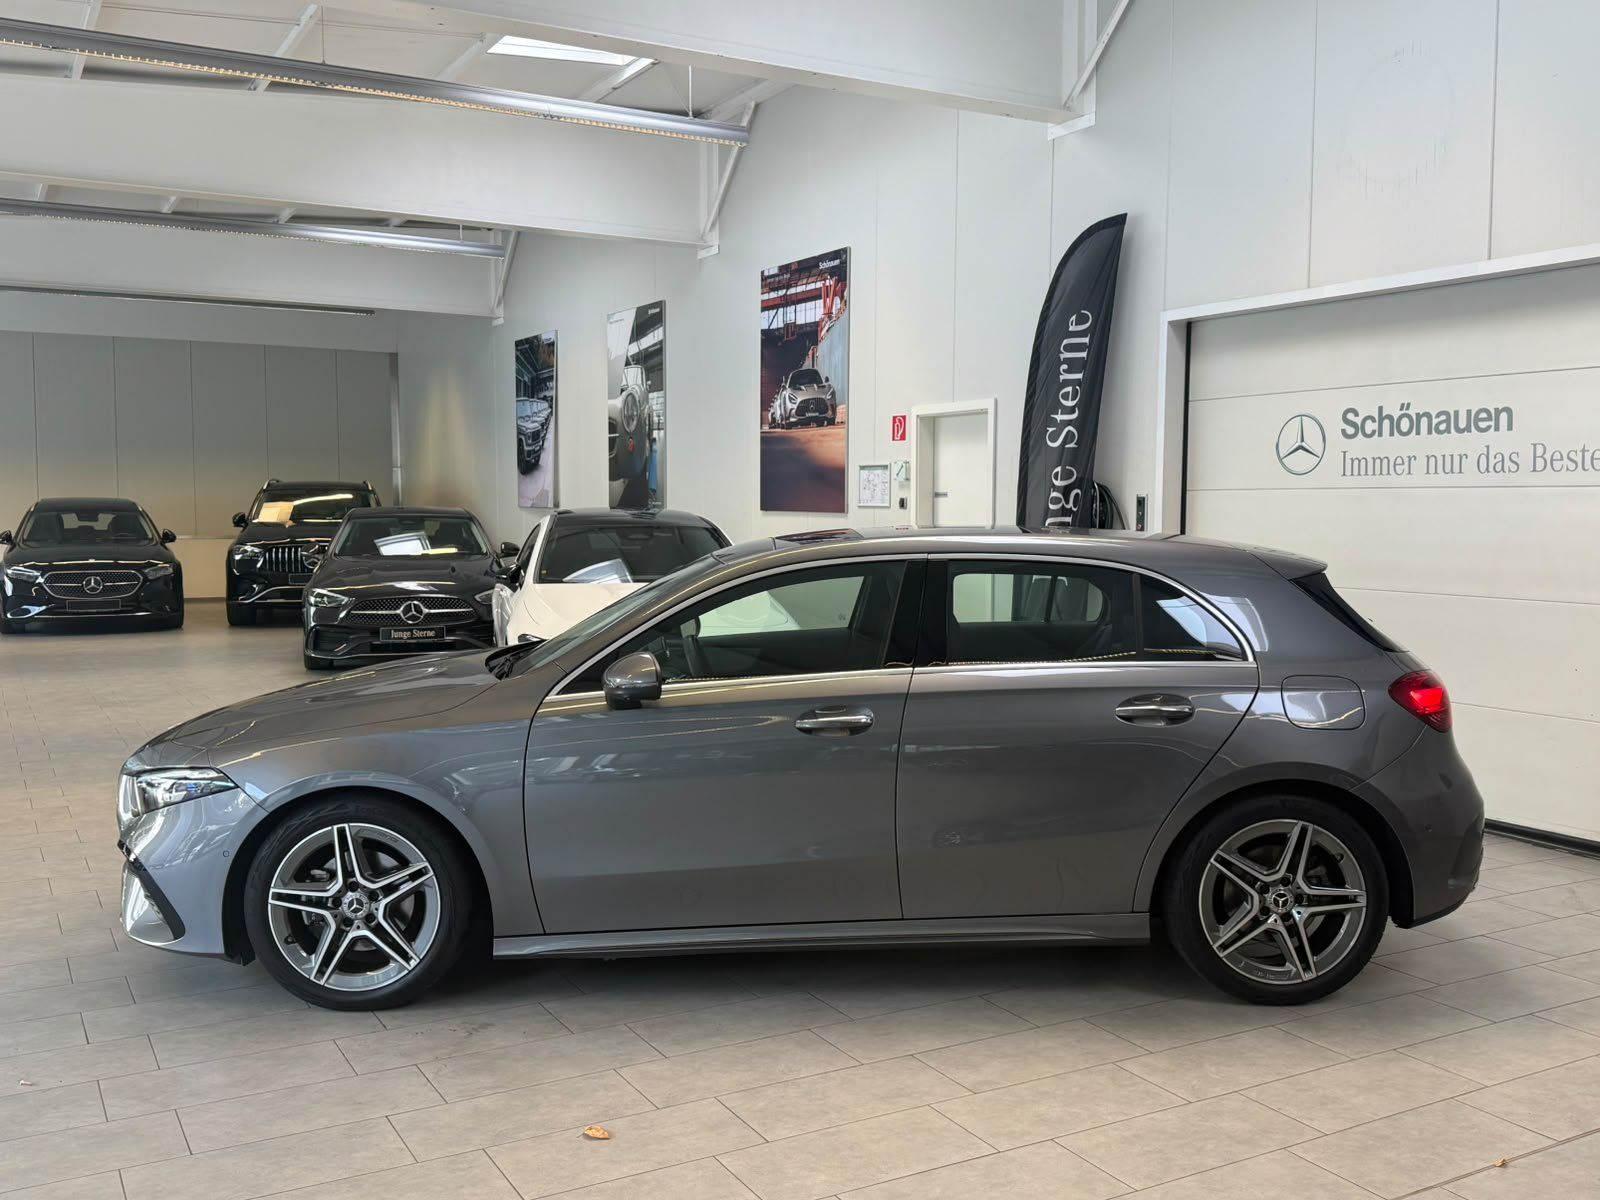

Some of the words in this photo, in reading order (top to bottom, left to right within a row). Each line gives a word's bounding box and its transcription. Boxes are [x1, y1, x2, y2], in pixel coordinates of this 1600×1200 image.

[1045, 309, 1093, 448] Sterne
[1340, 402, 1513, 440] Schönauen
[1340, 450, 1417, 477] Immer
[1424, 452, 1469, 475] nur
[1476, 444, 1520, 474] das
[1529, 442, 1600, 473] Beste
[391, 629, 411, 640] Junge
[412, 629, 436, 638] Sterne
